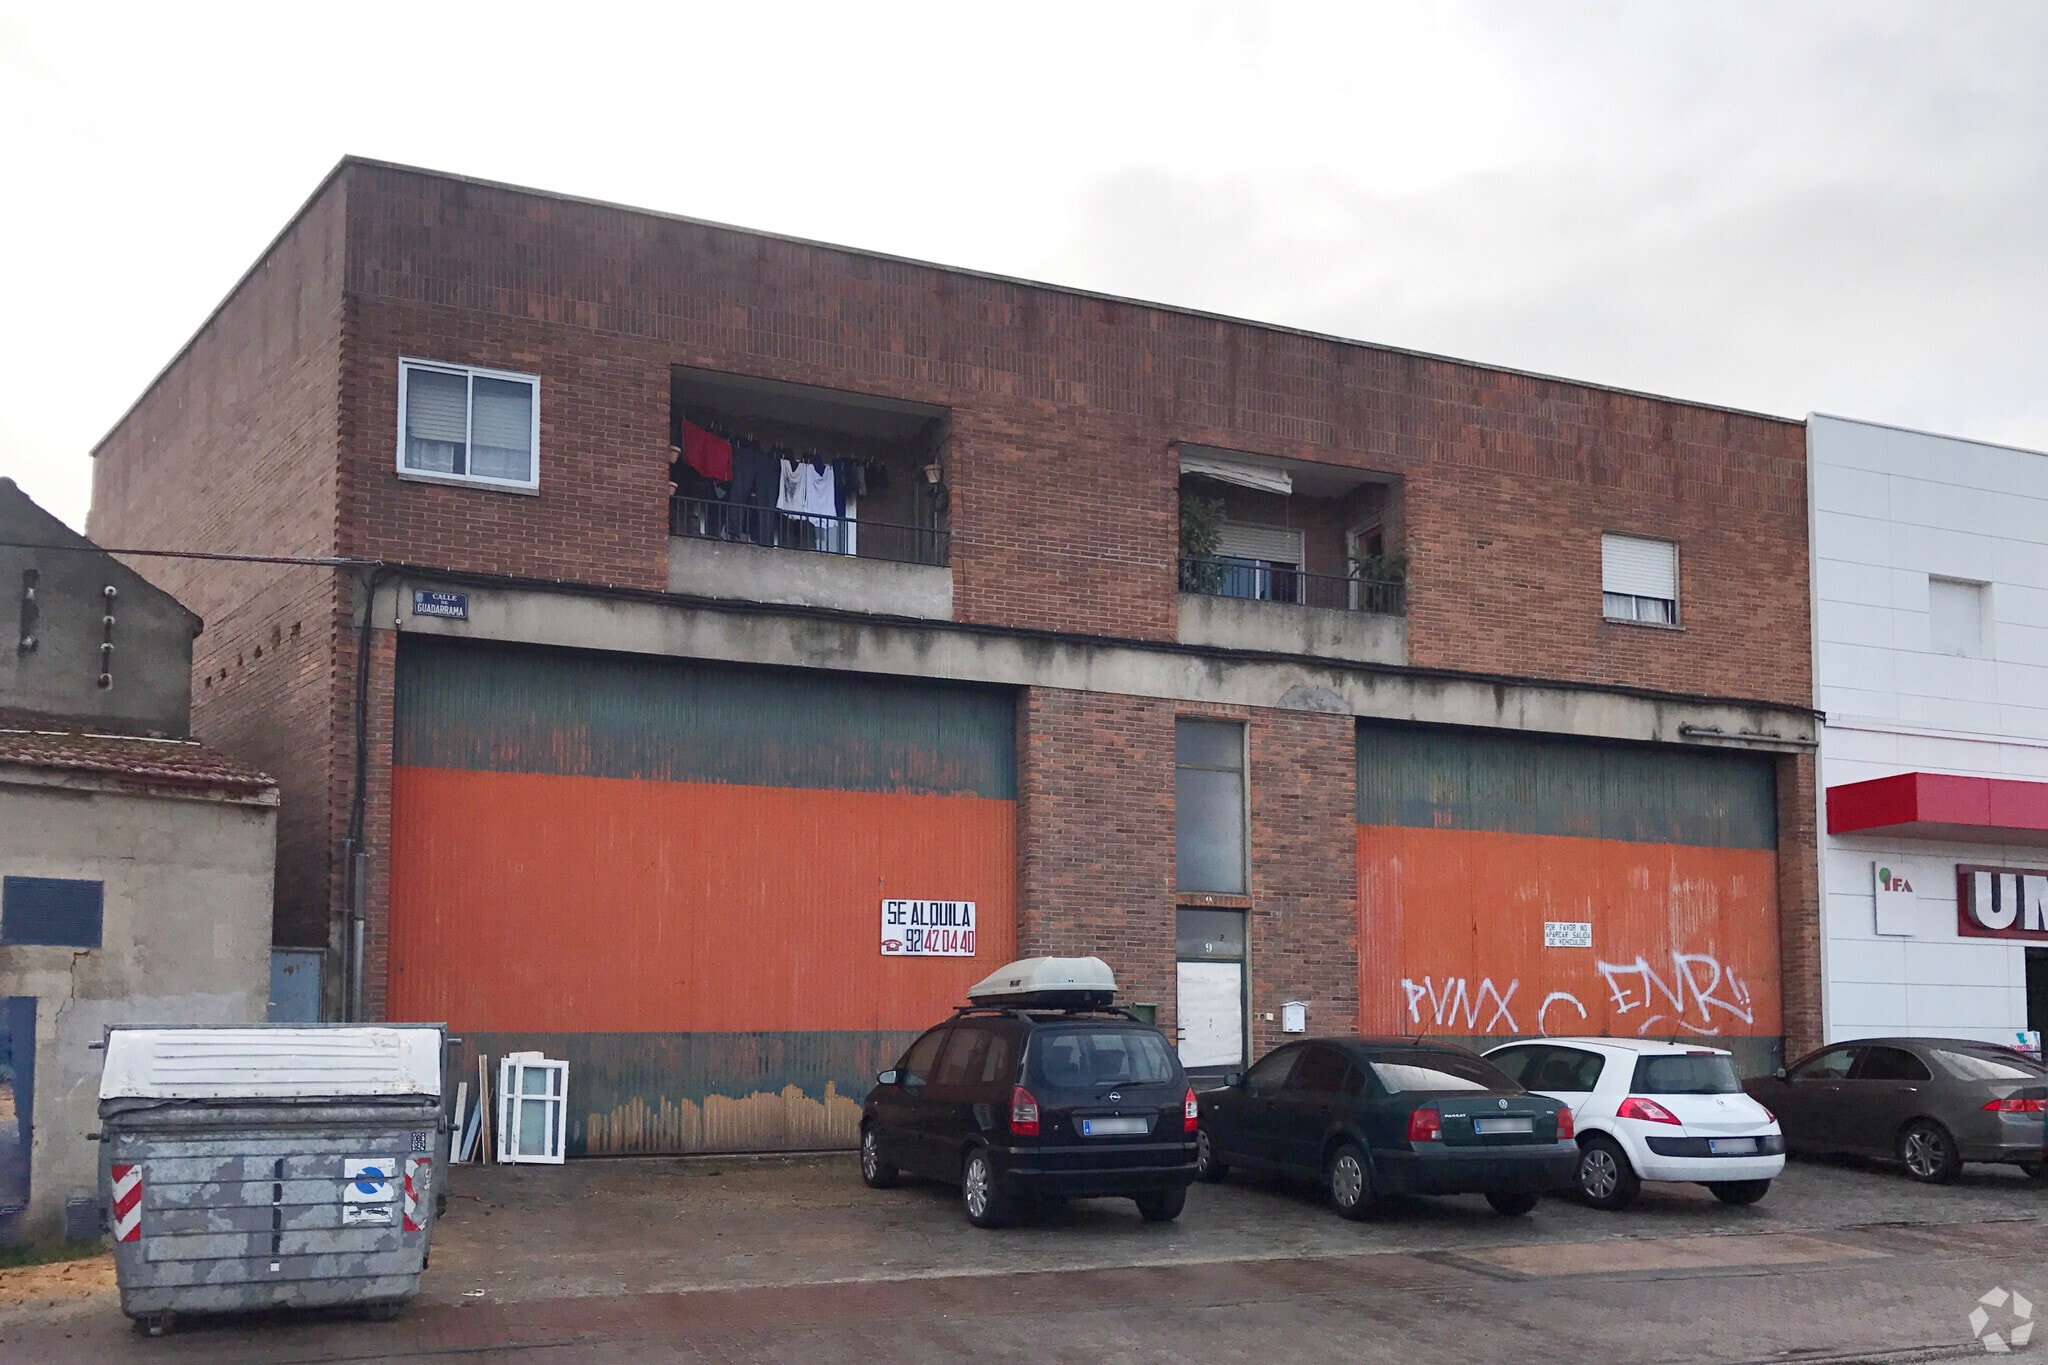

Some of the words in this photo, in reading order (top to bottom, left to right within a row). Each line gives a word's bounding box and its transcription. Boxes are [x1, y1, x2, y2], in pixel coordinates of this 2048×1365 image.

[432, 593, 458, 602] CALLE
[417, 603, 464, 617] GUADARRAMA
[1884, 876, 1913, 893] IFA
[888, 901, 907, 925] SE
[911, 902, 971, 929] ALQUILA
[1545, 923, 1556, 931] POR
[1572, 931, 1590, 939] SALIDA
[1205, 942, 1213, 953] 9
